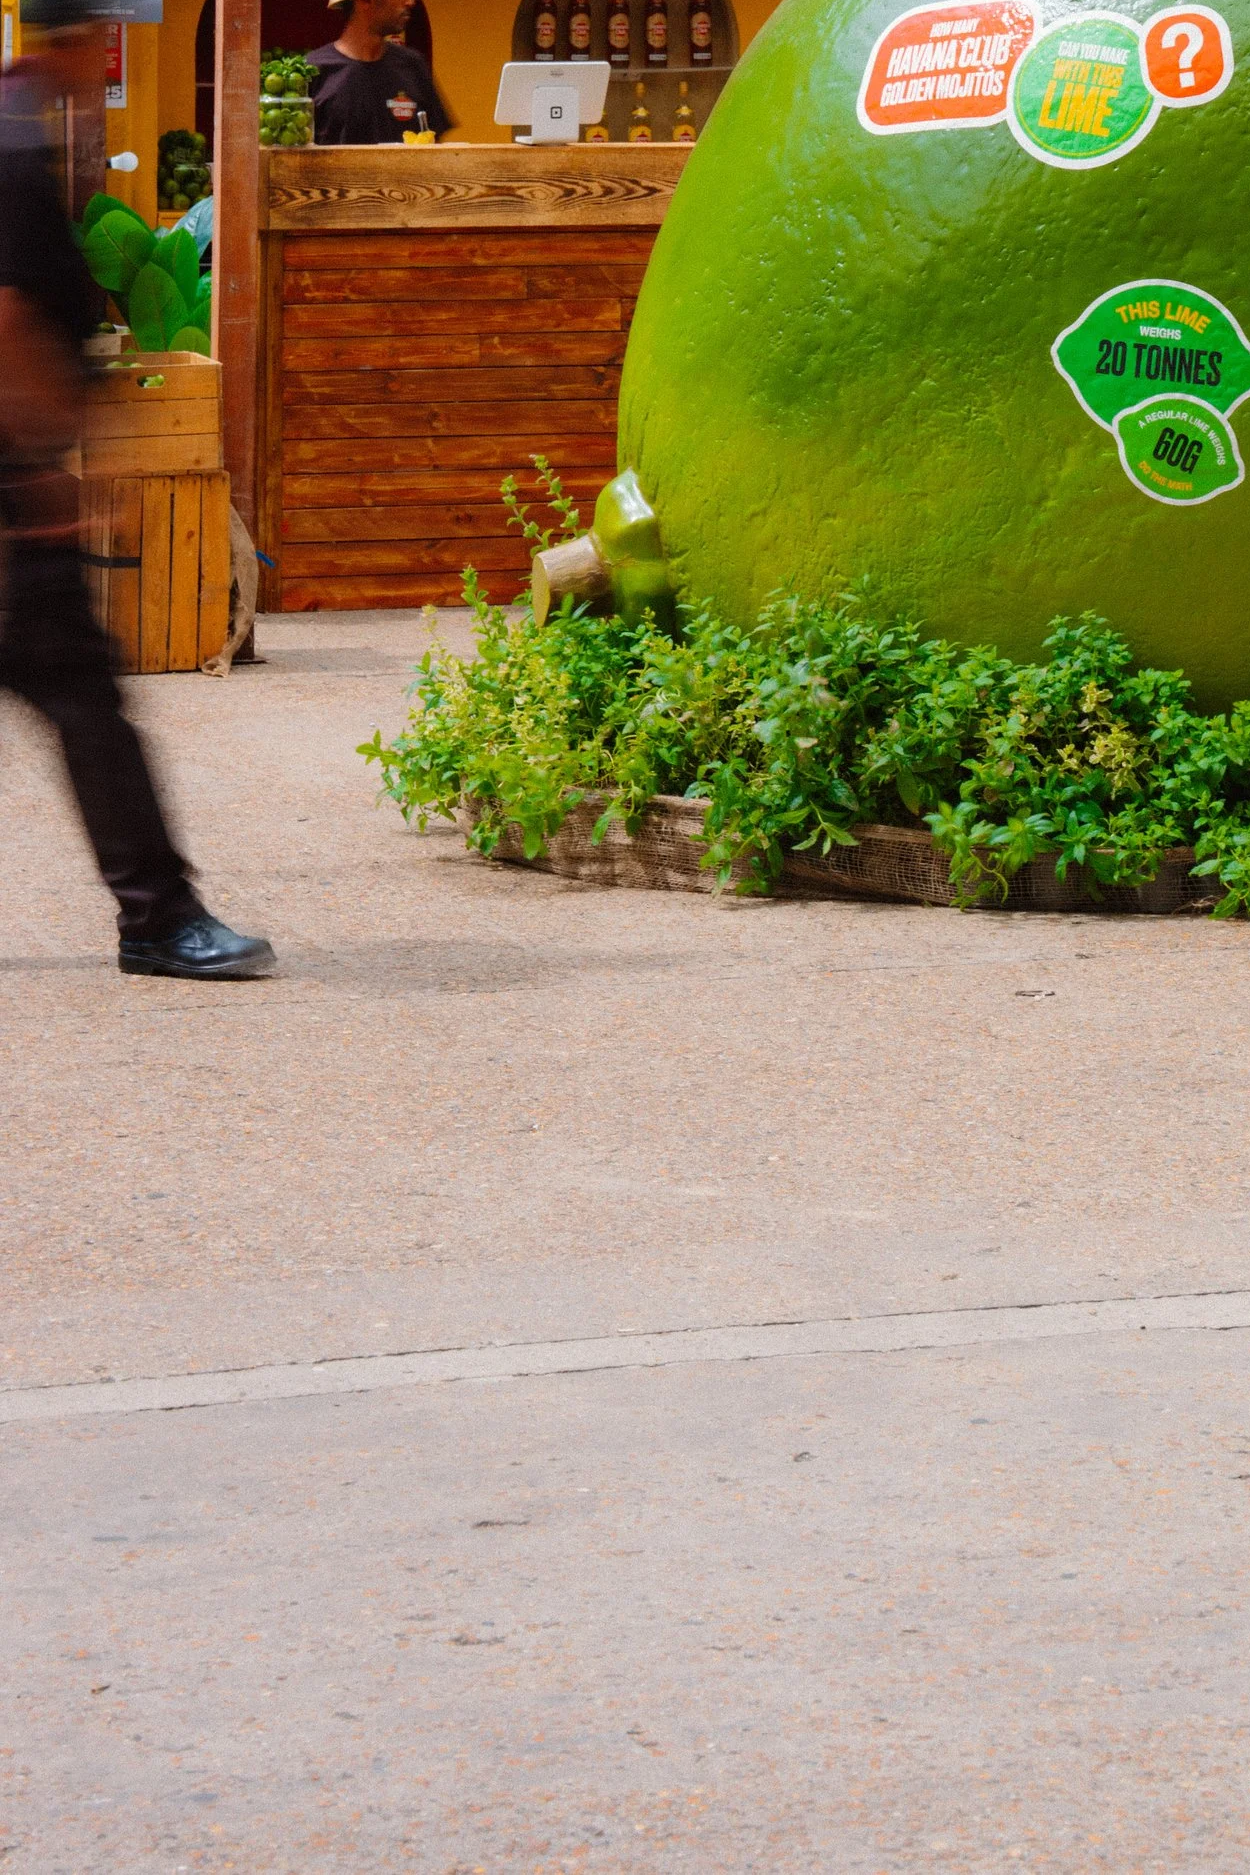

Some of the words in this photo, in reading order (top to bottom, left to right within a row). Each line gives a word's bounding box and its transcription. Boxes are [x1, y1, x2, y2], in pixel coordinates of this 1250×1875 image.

[930, 20, 953, 37] HOW
[951, 18, 981, 35] MANY
[886, 39, 958, 79] HAVANA
[957, 34, 1012, 67] CLUB
[1058, 41, 1080, 57] CAN
[1079, 42, 1100, 60] YOU
[1100, 45, 1131, 65] MAKE
[880, 75, 937, 107] GOLDEN
[935, 70, 1005, 99] MOJITOS
[1053, 58, 1092, 83] WITH
[1091, 62, 1125, 88] THIS
[1038, 79, 1119, 137] LIME
[1115, 301, 1161, 324] THIS
[1164, 302, 1212, 334] LIME
[1139, 325, 1182, 340] WEIGHS
[1096, 339, 1127, 376] 20
[1133, 343, 1223, 387] TONNES
[1138, 420, 1147, 429] A
[1144, 410, 1188, 424] REGULAR
[1188, 415, 1210, 434] LIME
[1207, 429, 1226, 466] WEIGHS
[1152, 427, 1203, 474] 60G
